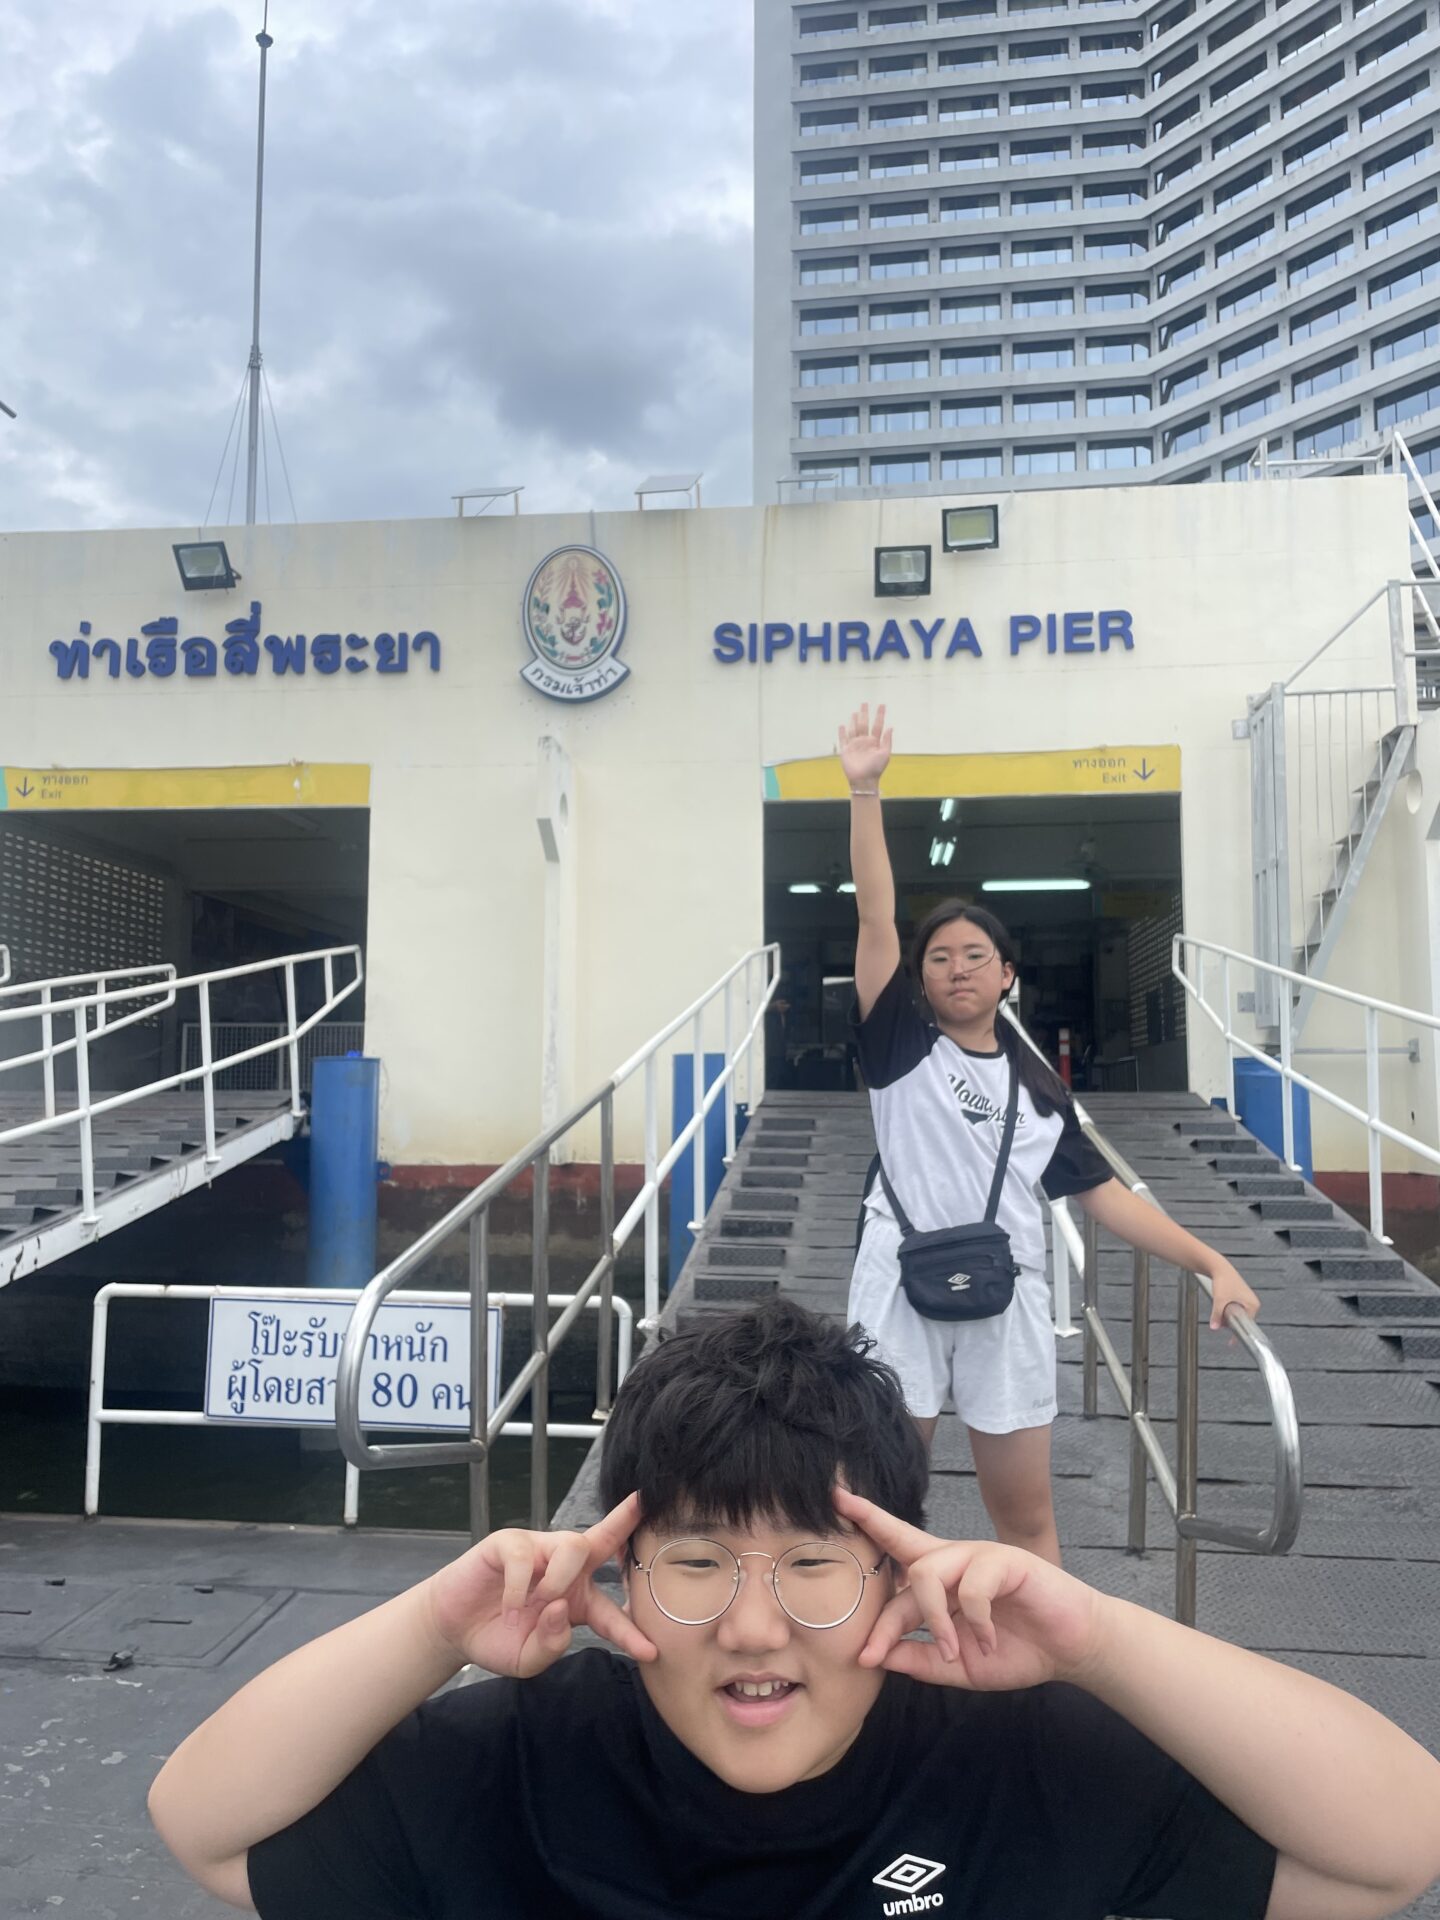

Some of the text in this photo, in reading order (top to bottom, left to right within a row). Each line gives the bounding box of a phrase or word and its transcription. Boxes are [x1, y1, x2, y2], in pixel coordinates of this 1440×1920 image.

[49, 601, 441, 680] ท่าเรือสี่พระยา
[713, 609, 1135, 664] SIPHRAYA PIER
[530, 667, 618, 695] กรมเจ้าท่า
[1072, 757, 1127, 769] ทางออก
[41, 774, 89, 786] ทางออก
[1102, 772, 1127, 784] Exit
[41, 789, 62, 800] Exit
[371, 1371, 418, 1408] 80
[883, 1893, 944, 1916] umbro
